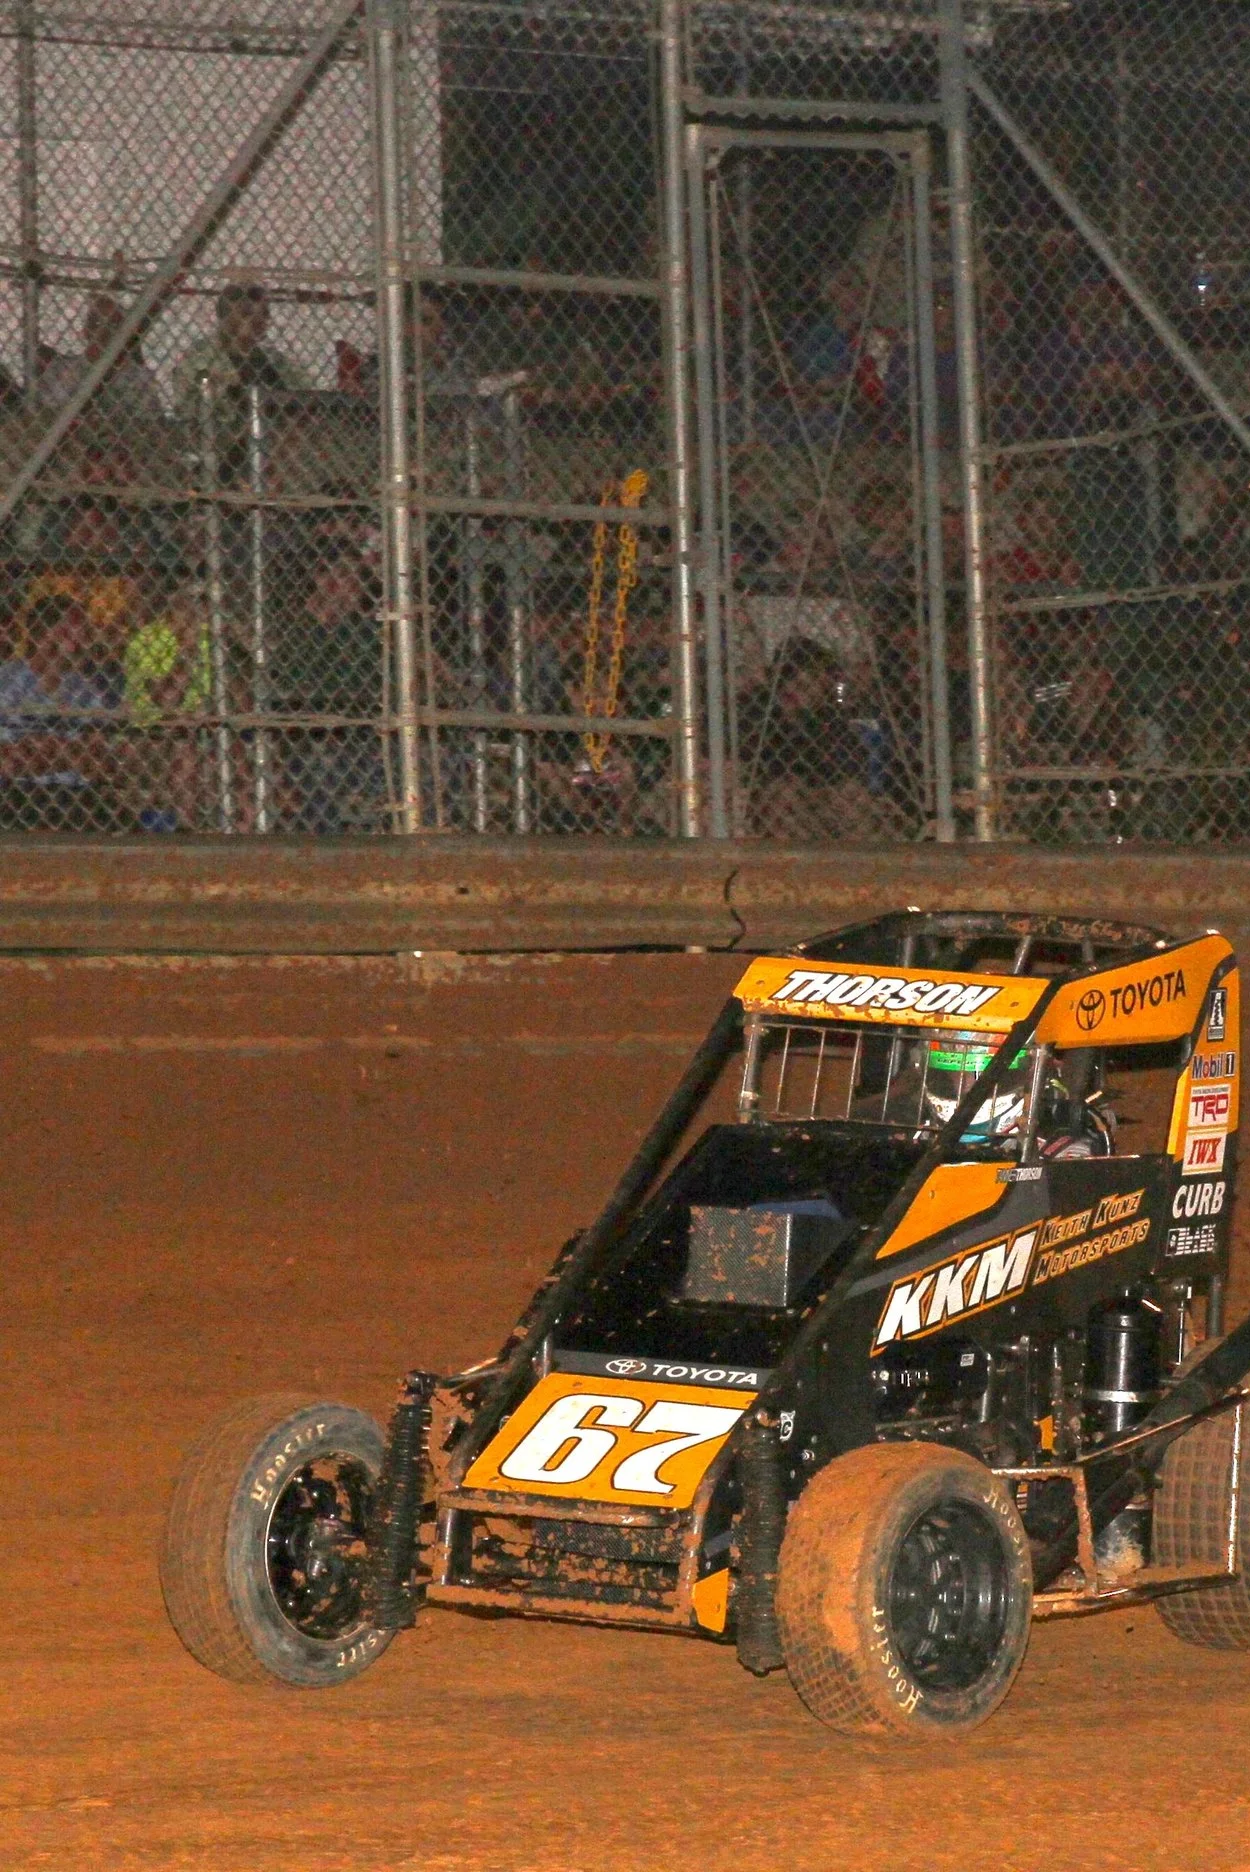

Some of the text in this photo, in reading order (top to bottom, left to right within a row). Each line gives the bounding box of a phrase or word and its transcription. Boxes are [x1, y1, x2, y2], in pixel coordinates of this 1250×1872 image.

[771, 970, 1002, 1015] THORSON
[1110, 970, 1186, 1017] TOYOTA
[1192, 1052, 1236, 1079] Mobil 1
[1191, 1093, 1229, 1123] TRD
[1172, 1181, 1226, 1219] CURB
[876, 1230, 1037, 1346] KKM
[652, 1364, 758, 1385] TOYOTA
[498, 1393, 748, 1494] 67
